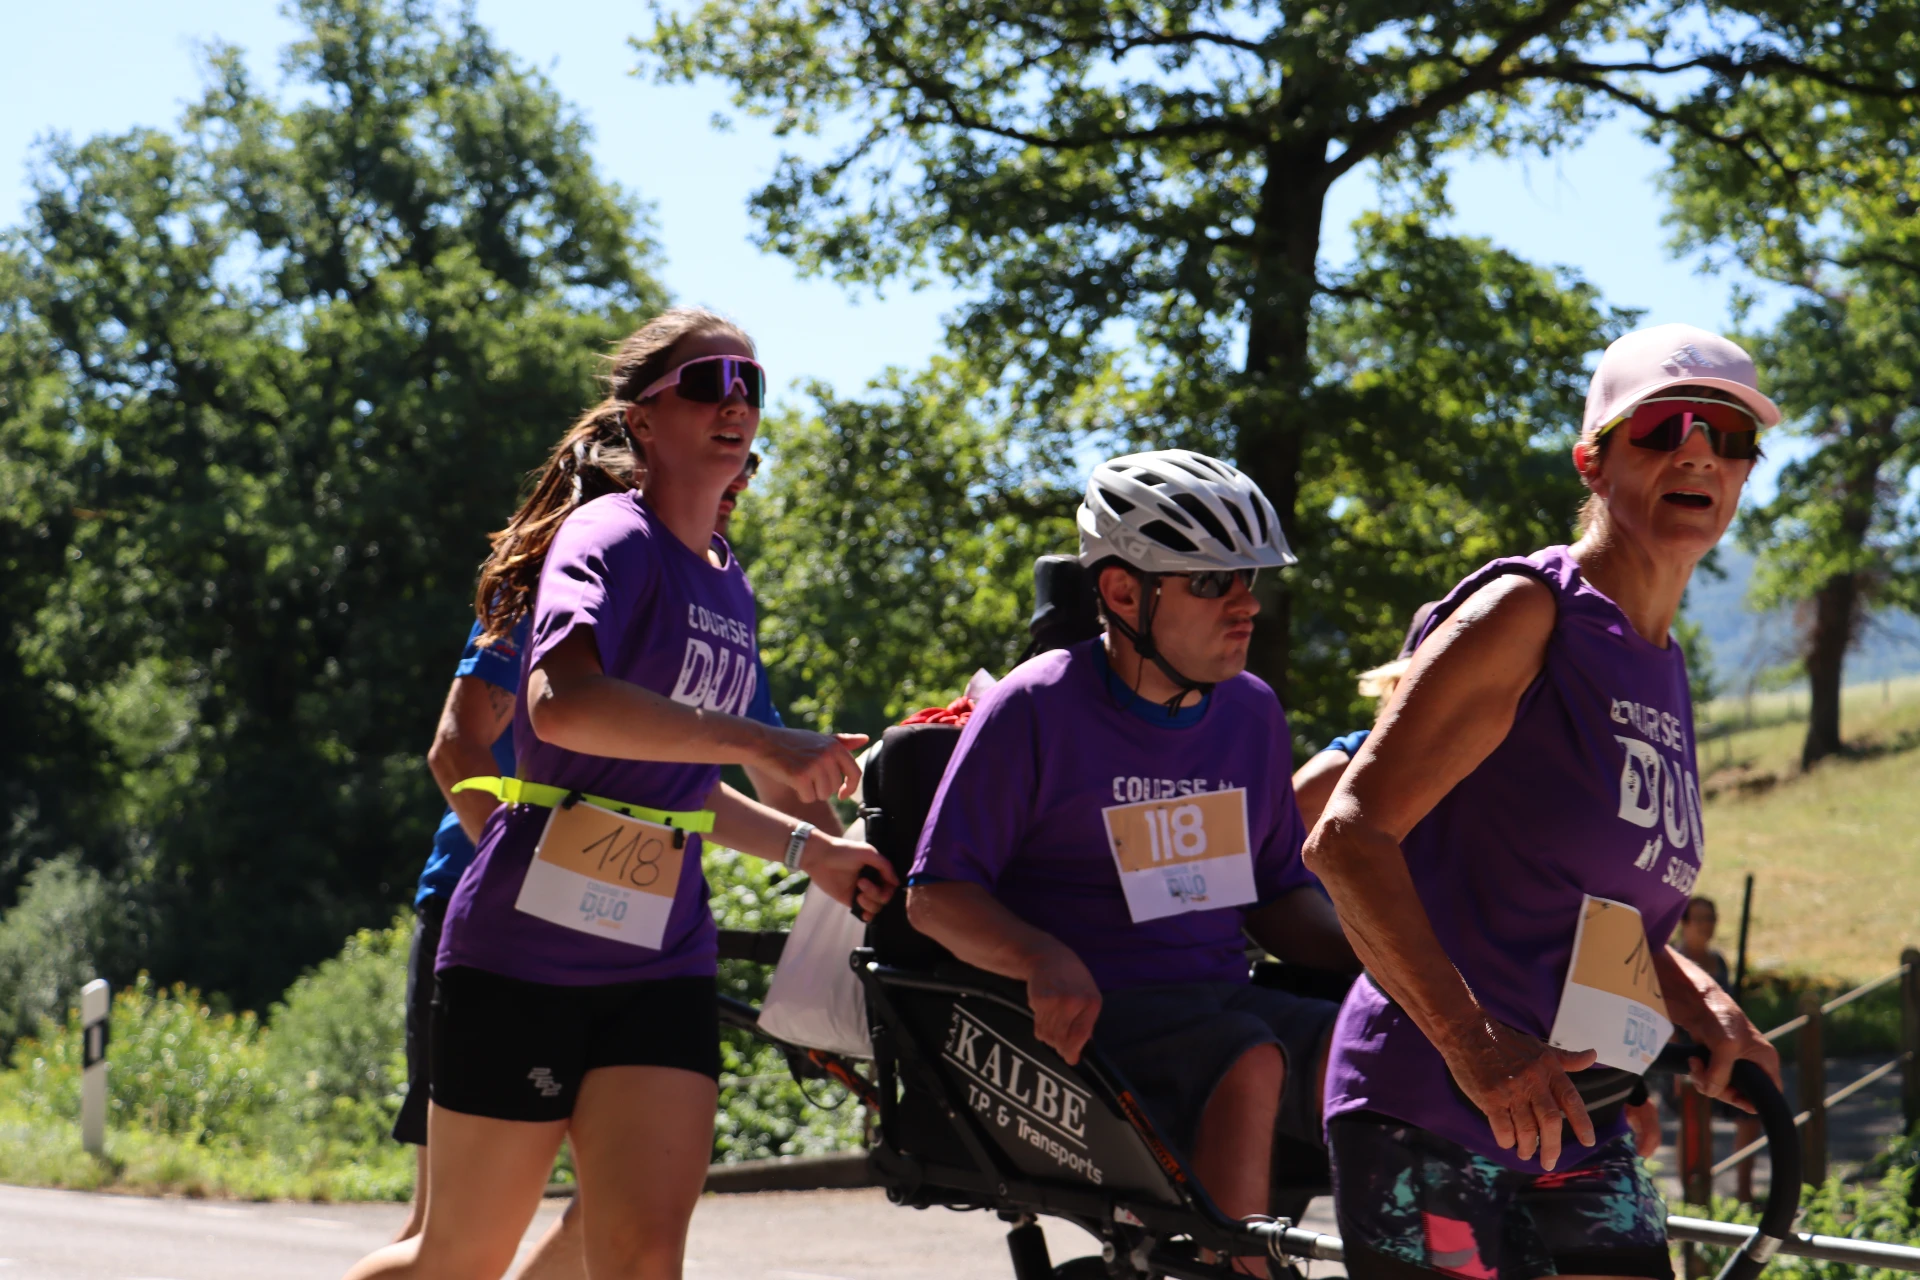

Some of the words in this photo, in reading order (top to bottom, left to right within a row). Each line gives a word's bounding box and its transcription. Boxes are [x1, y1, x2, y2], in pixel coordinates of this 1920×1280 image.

[688, 603, 749, 648] COURSE
[582, 824, 664, 886] 118
[1144, 804, 1207, 862] 118
[579, 892, 628, 921] DUO
[954, 1018, 1087, 1138] KALBE
[996, 1105, 1011, 1127] &
[1015, 1115, 1103, 1185] Transports
